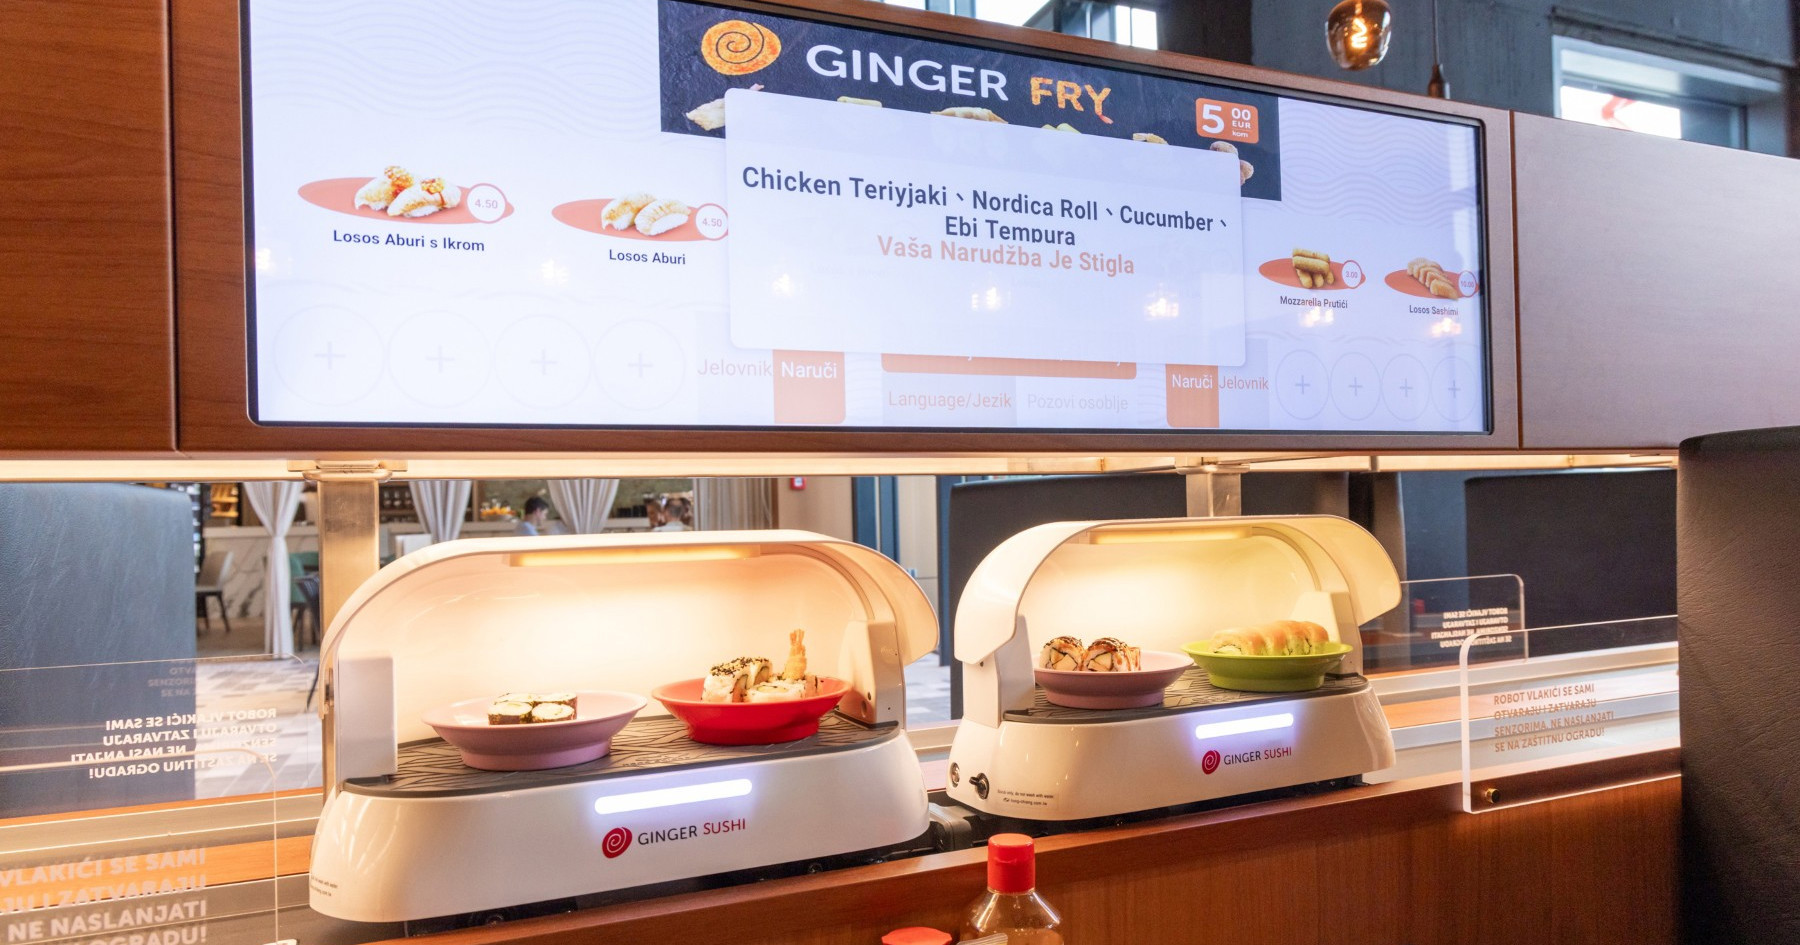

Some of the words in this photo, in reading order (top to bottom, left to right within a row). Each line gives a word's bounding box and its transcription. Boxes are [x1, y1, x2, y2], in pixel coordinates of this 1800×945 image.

[806, 44, 1009, 101] GINGER
[1030, 76, 1113, 124] FRY
[1202, 104, 1225, 134] 5
[1231, 107, 1251, 121] 00
[1232, 120, 1251, 129] EUR
[1232, 129, 1249, 138] kom
[474, 198, 498, 209] 4.50
[742, 166, 841, 196] Chicken
[849, 176, 947, 208] Teriyjaki
[972, 189, 1054, 217] Nordica
[1060, 198, 1098, 221] Roll
[1120, 205, 1214, 232] Cucumber
[702, 217, 722, 228] 4.50
[945, 215, 978, 237] Ebi
[984, 218, 1076, 246] Tempura
[333, 229, 380, 245] Losos
[385, 233, 425, 248] Aburi
[430, 239, 438, 249] s
[443, 237, 485, 252] Ikrom
[609, 249, 648, 263] Losos
[652, 252, 686, 265] Aburi
[877, 234, 932, 259] Vaša
[940, 239, 1042, 268] Narudžba
[1049, 249, 1073, 270] Je
[1079, 251, 1135, 278] Stigla
[1279, 295, 1322, 308] Mozzarella
[1409, 304, 1430, 315] Losos
[1432, 305, 1459, 317] Sashimi
[697, 358, 773, 377] Jelovnik
[781, 360, 838, 379] Naruči
[1172, 373, 1213, 389] Naruči
[1219, 375, 1270, 391] Jelovnik
[888, 390, 1013, 411] Language/Jezik
[1027, 393, 1074, 410] Pozovi
[1078, 395, 1129, 414] osoblje
[1494, 692, 1525, 705] ROBOT
[1527, 687, 1561, 701] VLAKIĆI
[1563, 686, 1573, 697] SE
[1574, 683, 1595, 695] SAMI
[1494, 704, 1540, 720] OTVARAJU
[1548, 699, 1597, 713] ZATVARAJU
[1551, 718, 1561, 728] NE
[1564, 711, 1614, 727] NASLANJATI
[1494, 741, 1505, 752] SE
[1507, 740, 1520, 750] NA
[1522, 733, 1564, 748] ZAŠTITNU
[1566, 727, 1605, 741] OGRADU!
[1223, 750, 1262, 765] GINGER
[1264, 747, 1292, 760] SUSHI
[637, 825, 698, 846] GINGER
[703, 818, 746, 836] SUSHI
[110, 857, 139, 875] SE
[146, 848, 205, 871] SAMI
[8, 921, 44, 942] NE
[50, 900, 206, 937] NASLANJATI
